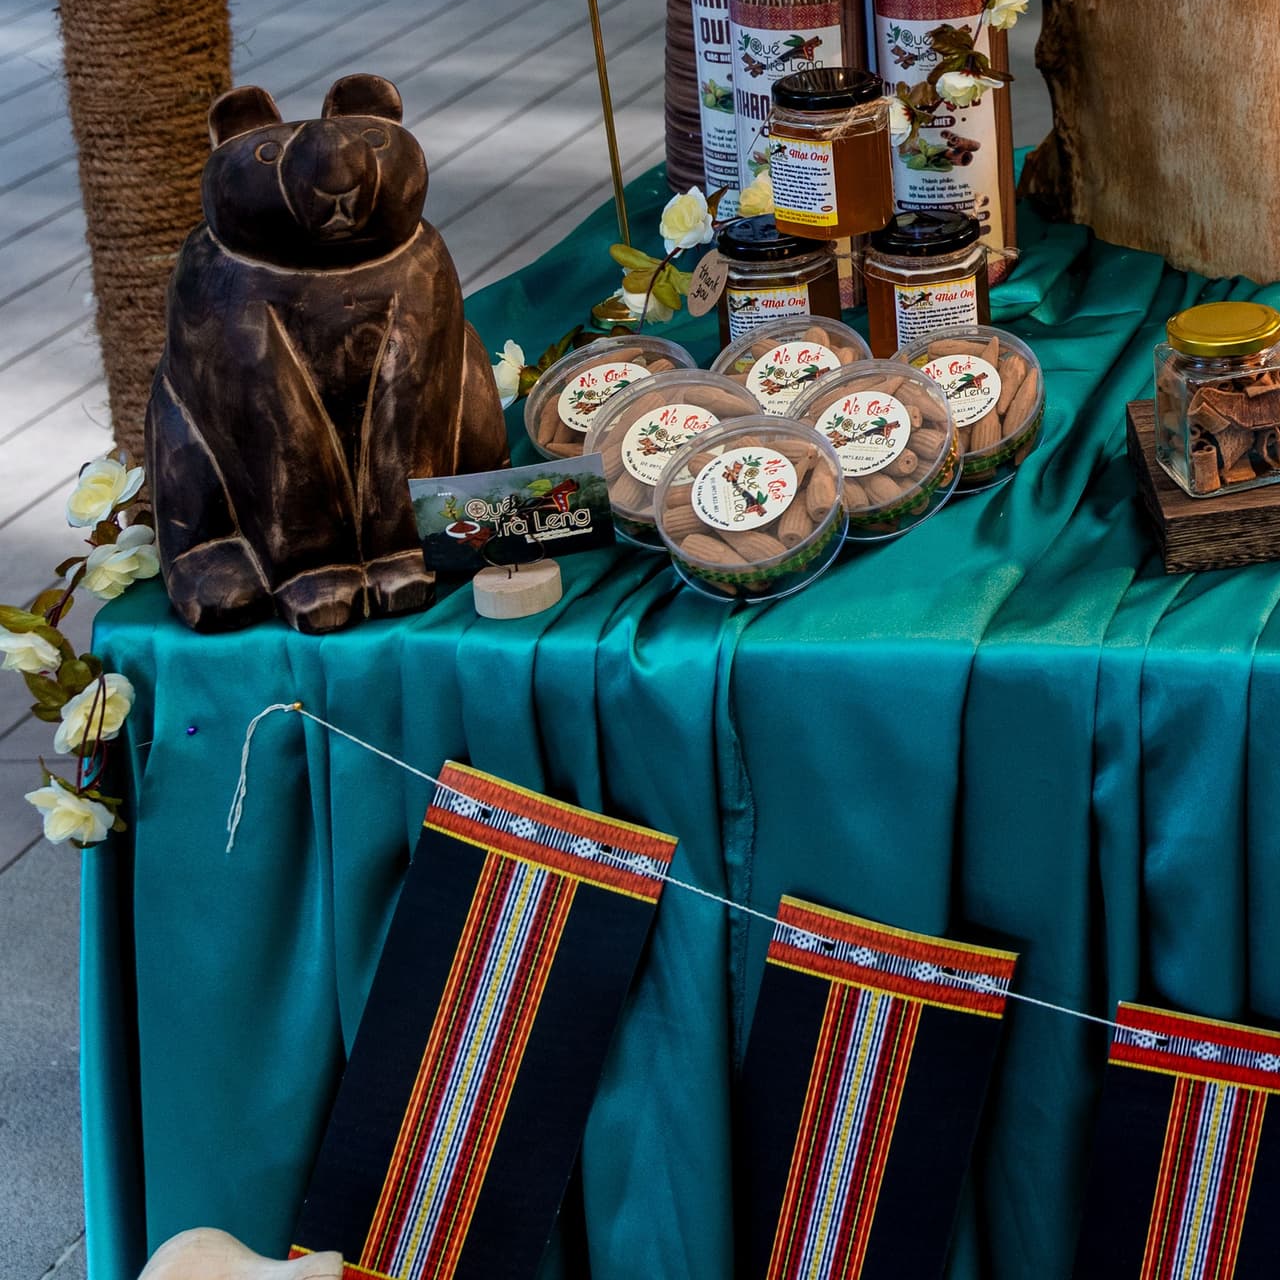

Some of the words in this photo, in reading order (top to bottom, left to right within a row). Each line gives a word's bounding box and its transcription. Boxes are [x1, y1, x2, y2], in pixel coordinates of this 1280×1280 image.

[750, 37, 782, 57] Quế
[763, 55, 786, 72] Trà
[788, 148, 808, 161] Mật
[810, 151, 829, 163] Ong
[700, 264, 720, 291] thank
[693, 284, 709, 301] you
[935, 291, 958, 303] Mật
[761, 298, 785, 310] Mật
[786, 297, 806, 309] Ong
[773, 347, 791, 365] Nụ
[797, 347, 825, 365] Quế
[579, 372, 598, 388] Nụ
[604, 363, 633, 384] Quế
[924, 362, 943, 380] Nụ
[948, 356, 976, 376] Quế
[964, 384, 991, 398] Leng
[843, 396, 861, 416] Nụ
[866, 398, 896, 417] Quế
[659, 407, 678, 427] Nụ
[869, 432, 896, 448] Leng
[764, 458, 787, 476] Nụ
[767, 478, 793, 503] Quế
[464, 495, 518, 521] Quế
[733, 499, 746, 523] Leng
[533, 508, 592, 533] Leng
